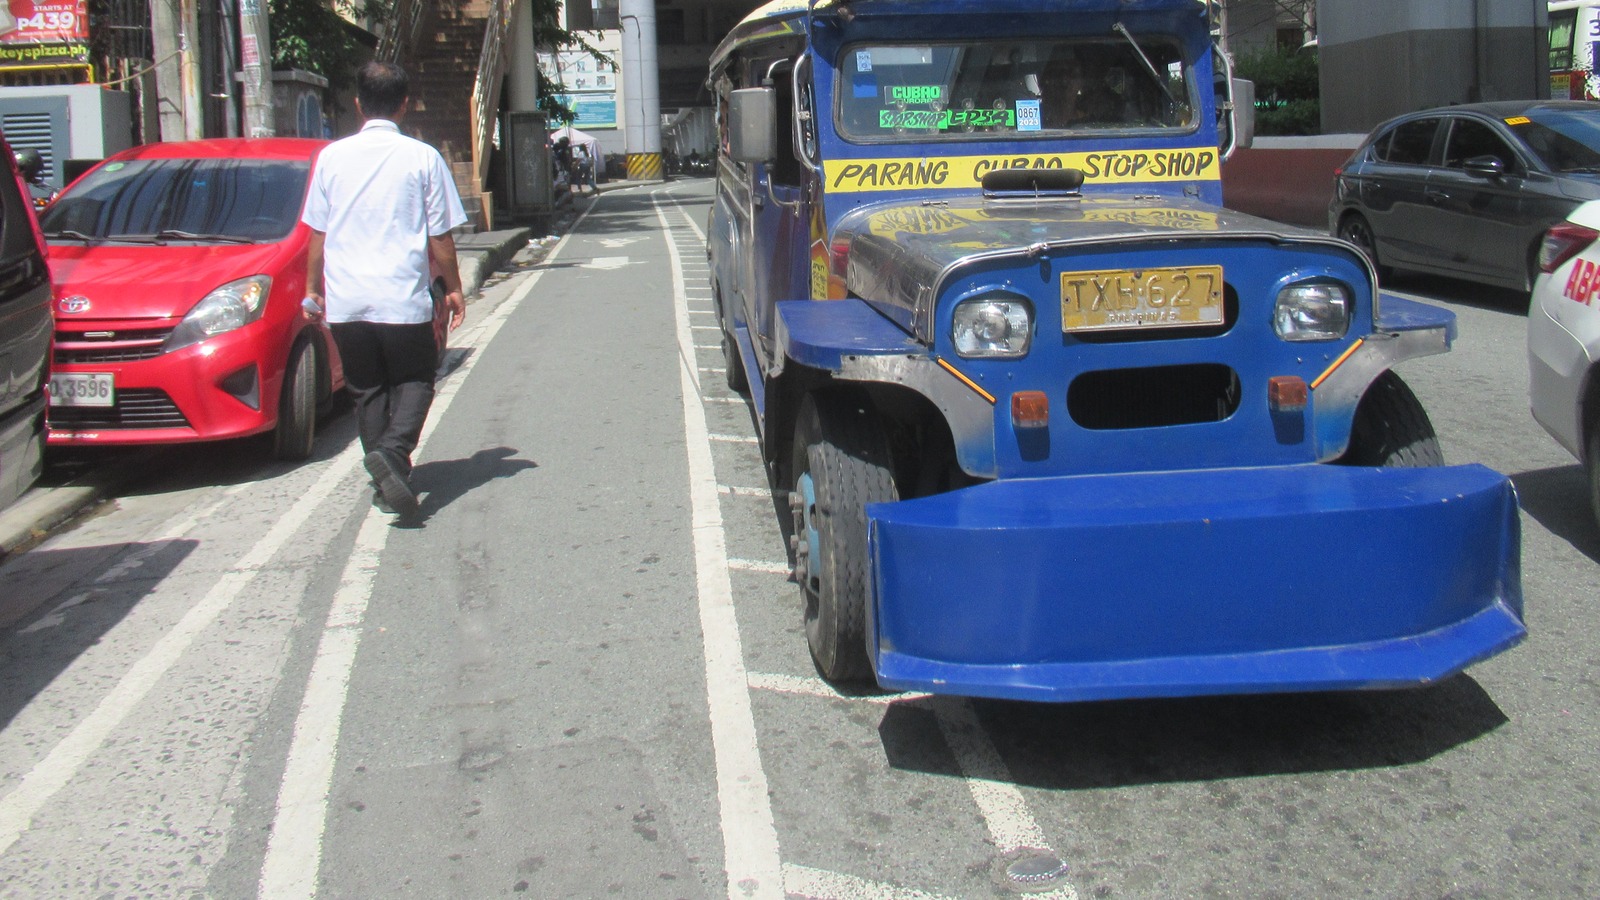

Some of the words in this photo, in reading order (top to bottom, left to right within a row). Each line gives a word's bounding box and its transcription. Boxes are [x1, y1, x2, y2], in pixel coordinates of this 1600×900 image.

[33, 4, 62, 12] STARTS
[17, 11, 75, 31] P439
[892, 85, 940, 99] CUBAO
[1018, 107, 1038, 118] 0867
[1018, 118, 1039, 126] 2023
[834, 161, 948, 188] PARANG
